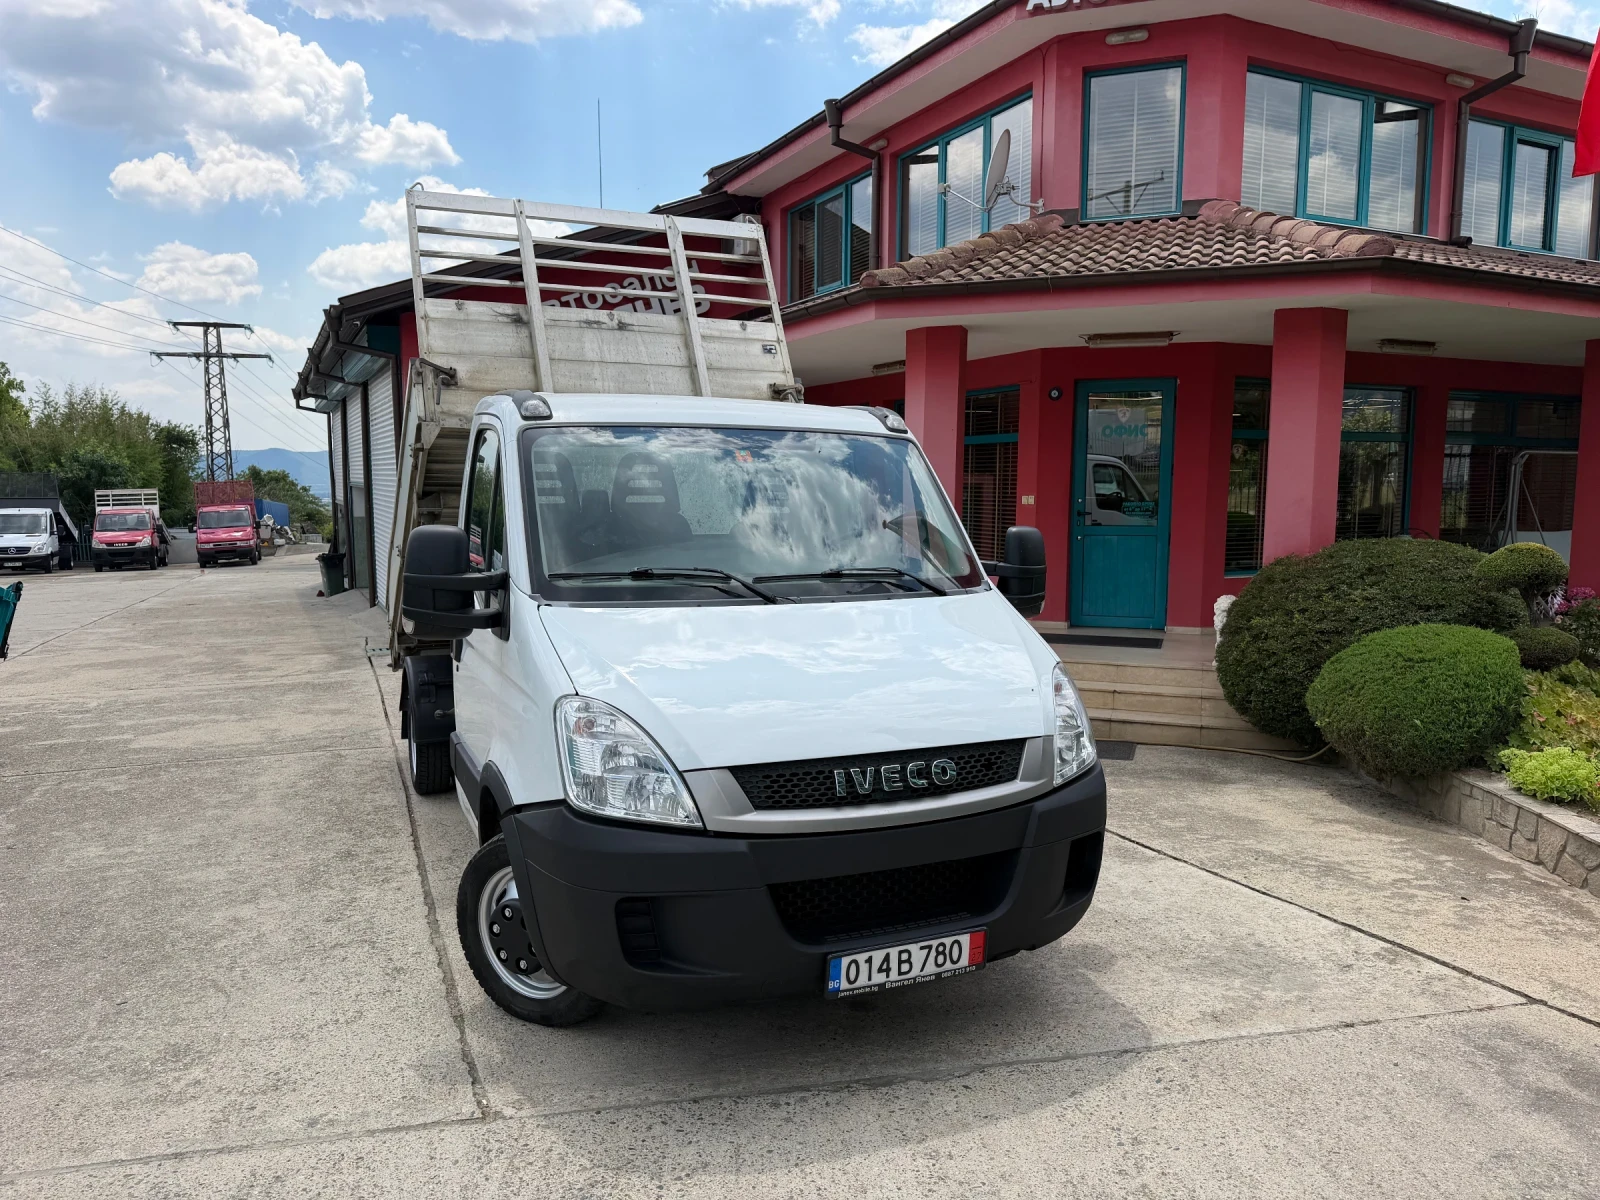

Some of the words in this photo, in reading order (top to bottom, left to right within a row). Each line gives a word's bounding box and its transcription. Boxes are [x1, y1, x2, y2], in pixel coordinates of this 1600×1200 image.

[1101, 423, 1148, 439] ОФИС
[834, 759, 957, 796] IVECO
[828, 980, 840, 989] BG
[845, 939, 963, 985] 014B780
[885, 979, 914, 989] Вангел
[915, 974, 936, 984] Янев
